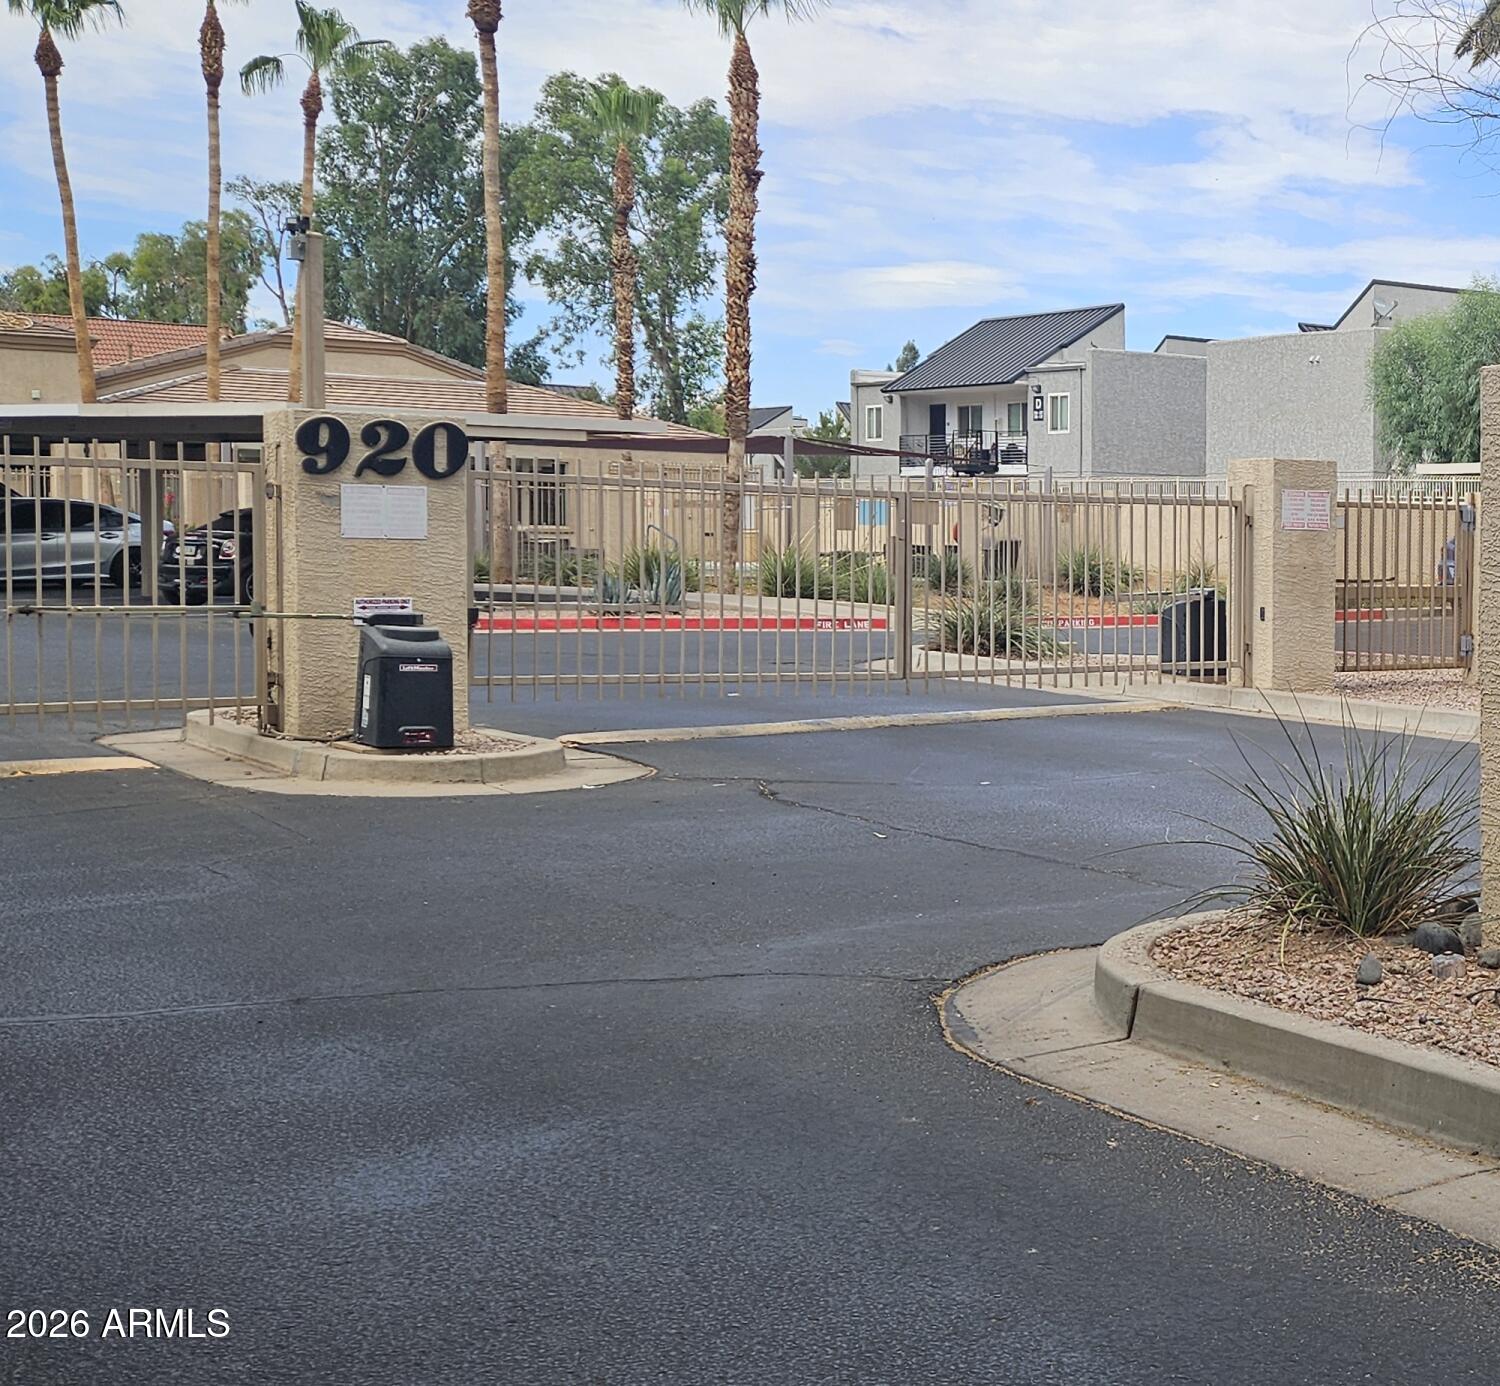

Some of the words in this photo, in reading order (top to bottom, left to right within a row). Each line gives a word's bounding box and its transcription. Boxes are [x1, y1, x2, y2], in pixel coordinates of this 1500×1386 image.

[1035, 398, 1041, 409] D
[294, 414, 469, 480] 920
[1058, 618, 1095, 626] PARKIG
